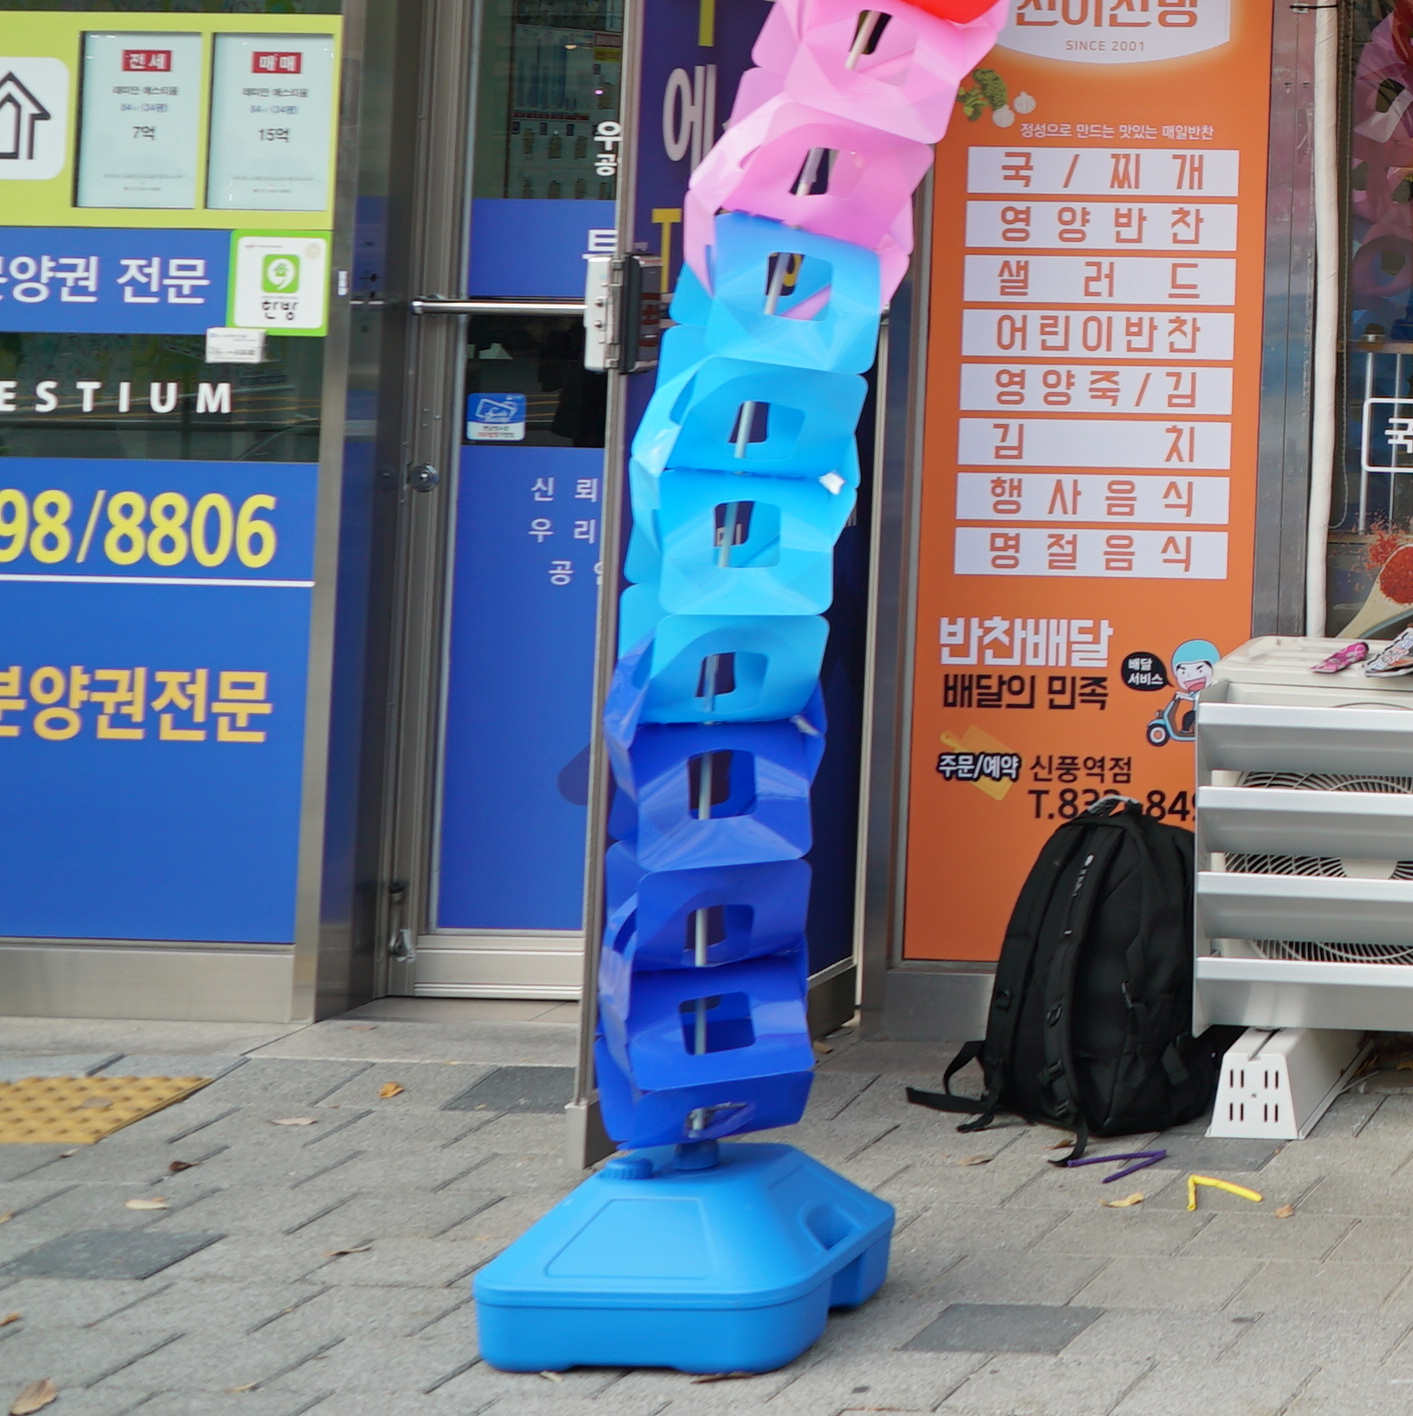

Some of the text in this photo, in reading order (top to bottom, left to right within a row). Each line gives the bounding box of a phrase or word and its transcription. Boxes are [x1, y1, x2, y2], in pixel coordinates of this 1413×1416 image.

[1065, 40, 1145, 52] SINCE 2001
[133, 125, 157, 141] 7억
[259, 127, 290, 144] 15억
[1020, 123, 1214, 141] 정성으로 만드는 맛있는 매일반찬
[116, 258, 210, 306] 전문
[940, 616, 1114, 668] 반찬배달
[1128, 658, 1153, 671] 배달
[1127, 672, 1164, 686] 서비스
[943, 674, 1109, 711] 배달의 민족
[938, 753, 1021, 780] 주문/예약
[1030, 755, 1132, 784] 신풍역점
